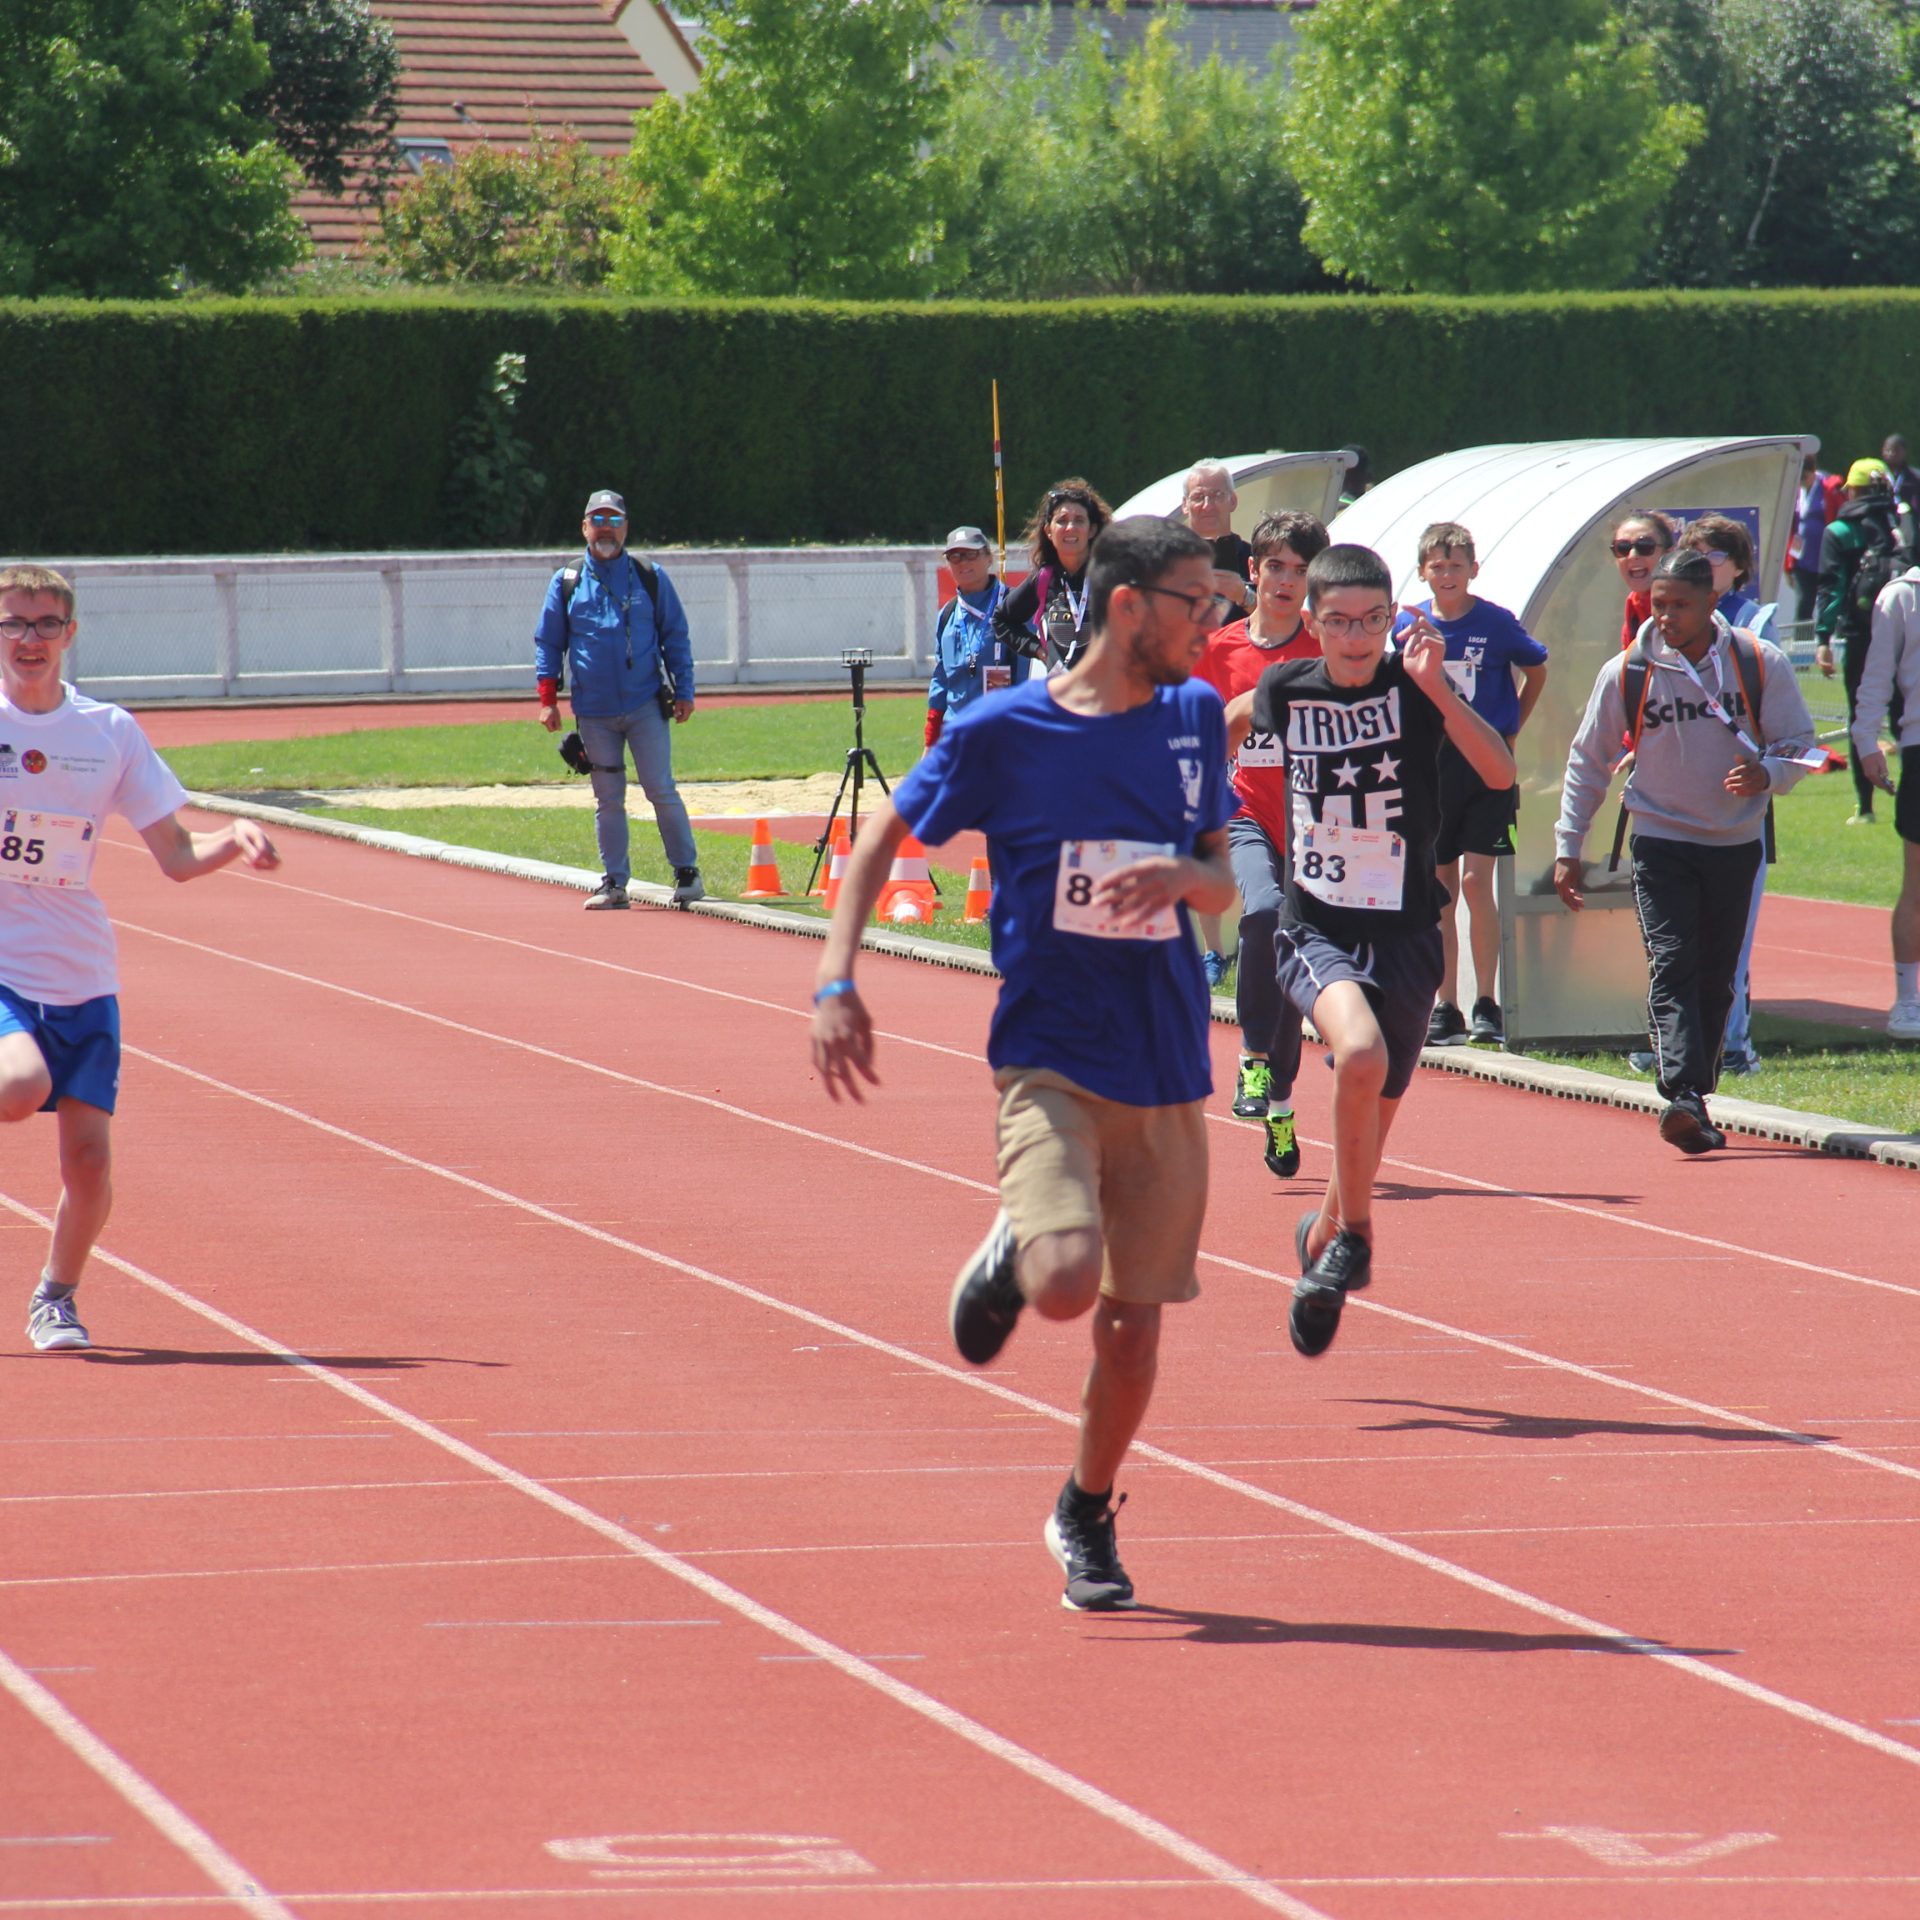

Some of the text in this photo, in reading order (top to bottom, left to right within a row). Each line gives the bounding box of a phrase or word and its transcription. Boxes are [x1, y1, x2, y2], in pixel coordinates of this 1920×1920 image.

[1468, 636, 1488, 644] LUCAS
[1294, 700, 1396, 747] TRUST
[1243, 731, 1275, 750] 82
[0, 835, 45, 865] 85
[1302, 850, 1346, 883] 83
